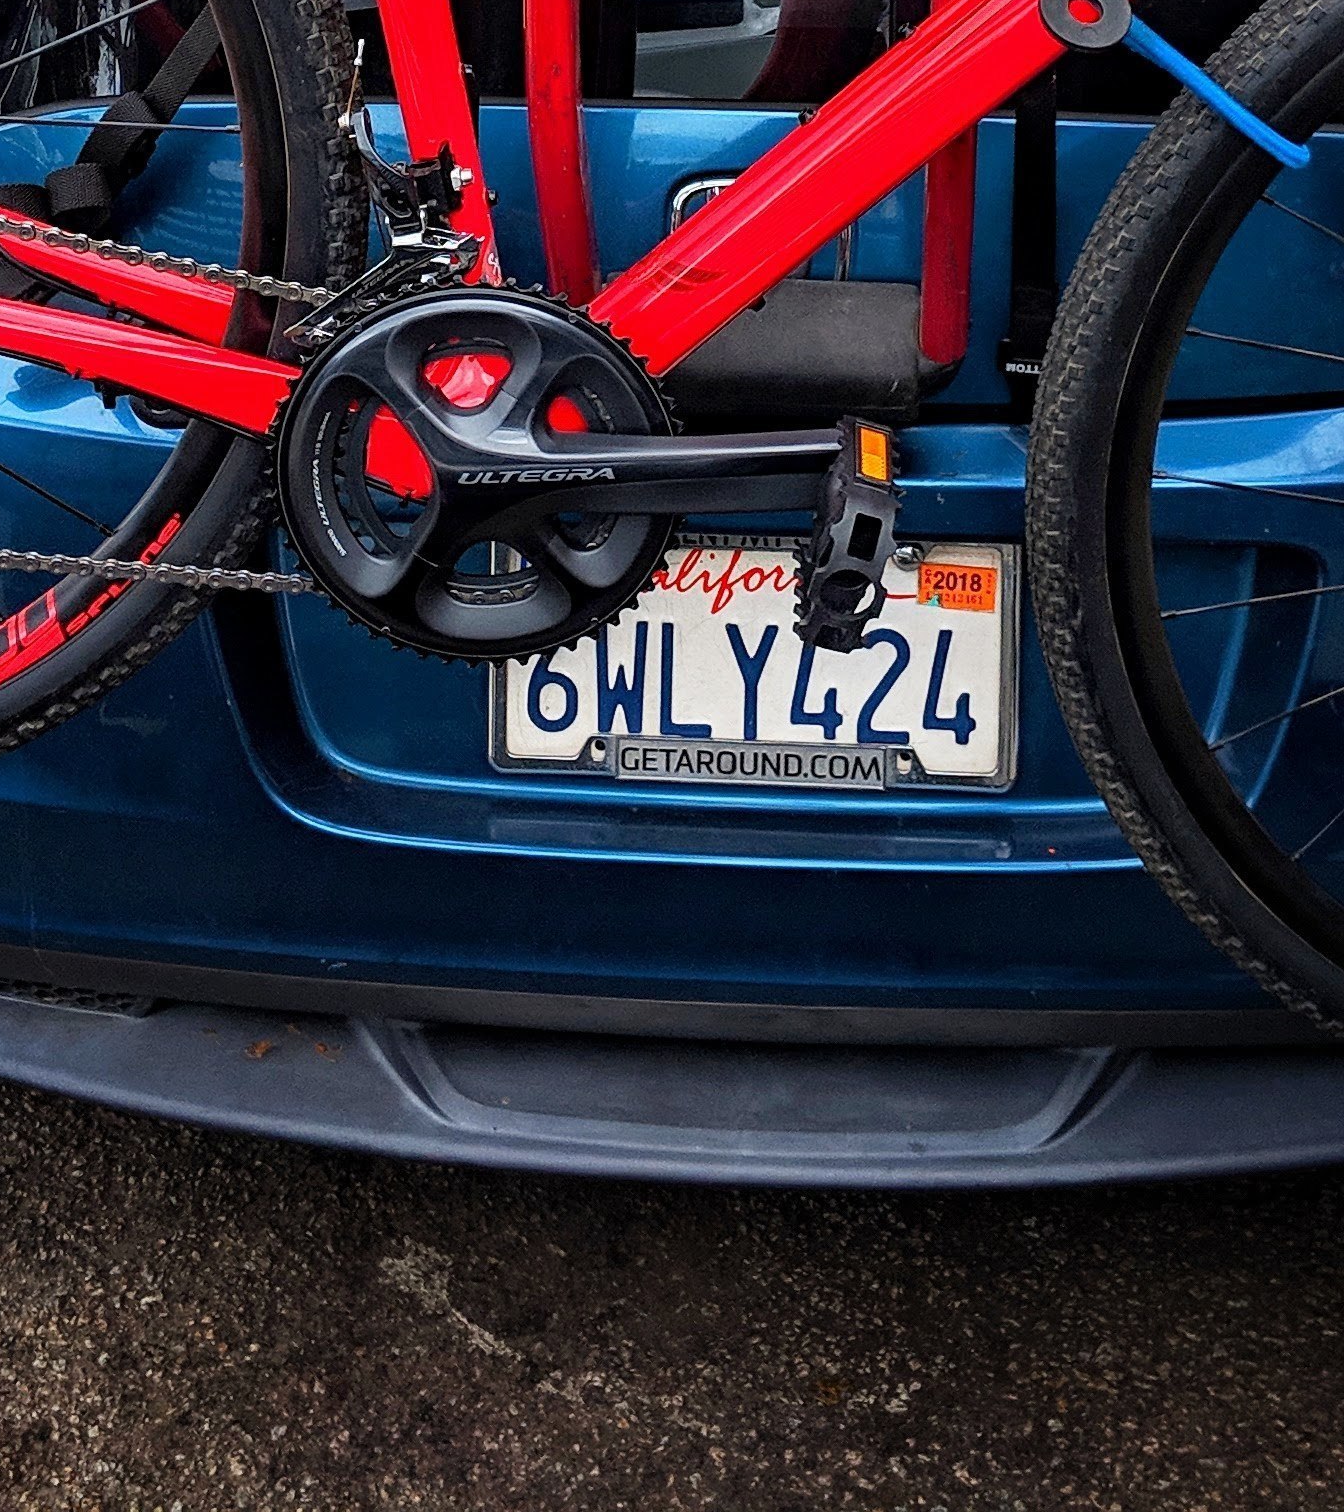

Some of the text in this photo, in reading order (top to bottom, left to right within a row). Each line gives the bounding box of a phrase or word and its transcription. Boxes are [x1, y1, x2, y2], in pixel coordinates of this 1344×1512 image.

[1006, 363, 1041, 375] TTOM
[313, 459, 330, 526] ULTEGRA
[457, 467, 616, 485] ULTEGRA
[644, 548, 803, 614] alifor
[933, 571, 982, 592] 2018
[528, 621, 977, 745] 6WLY424
[621, 747, 882, 781] GETAROUND.COM
